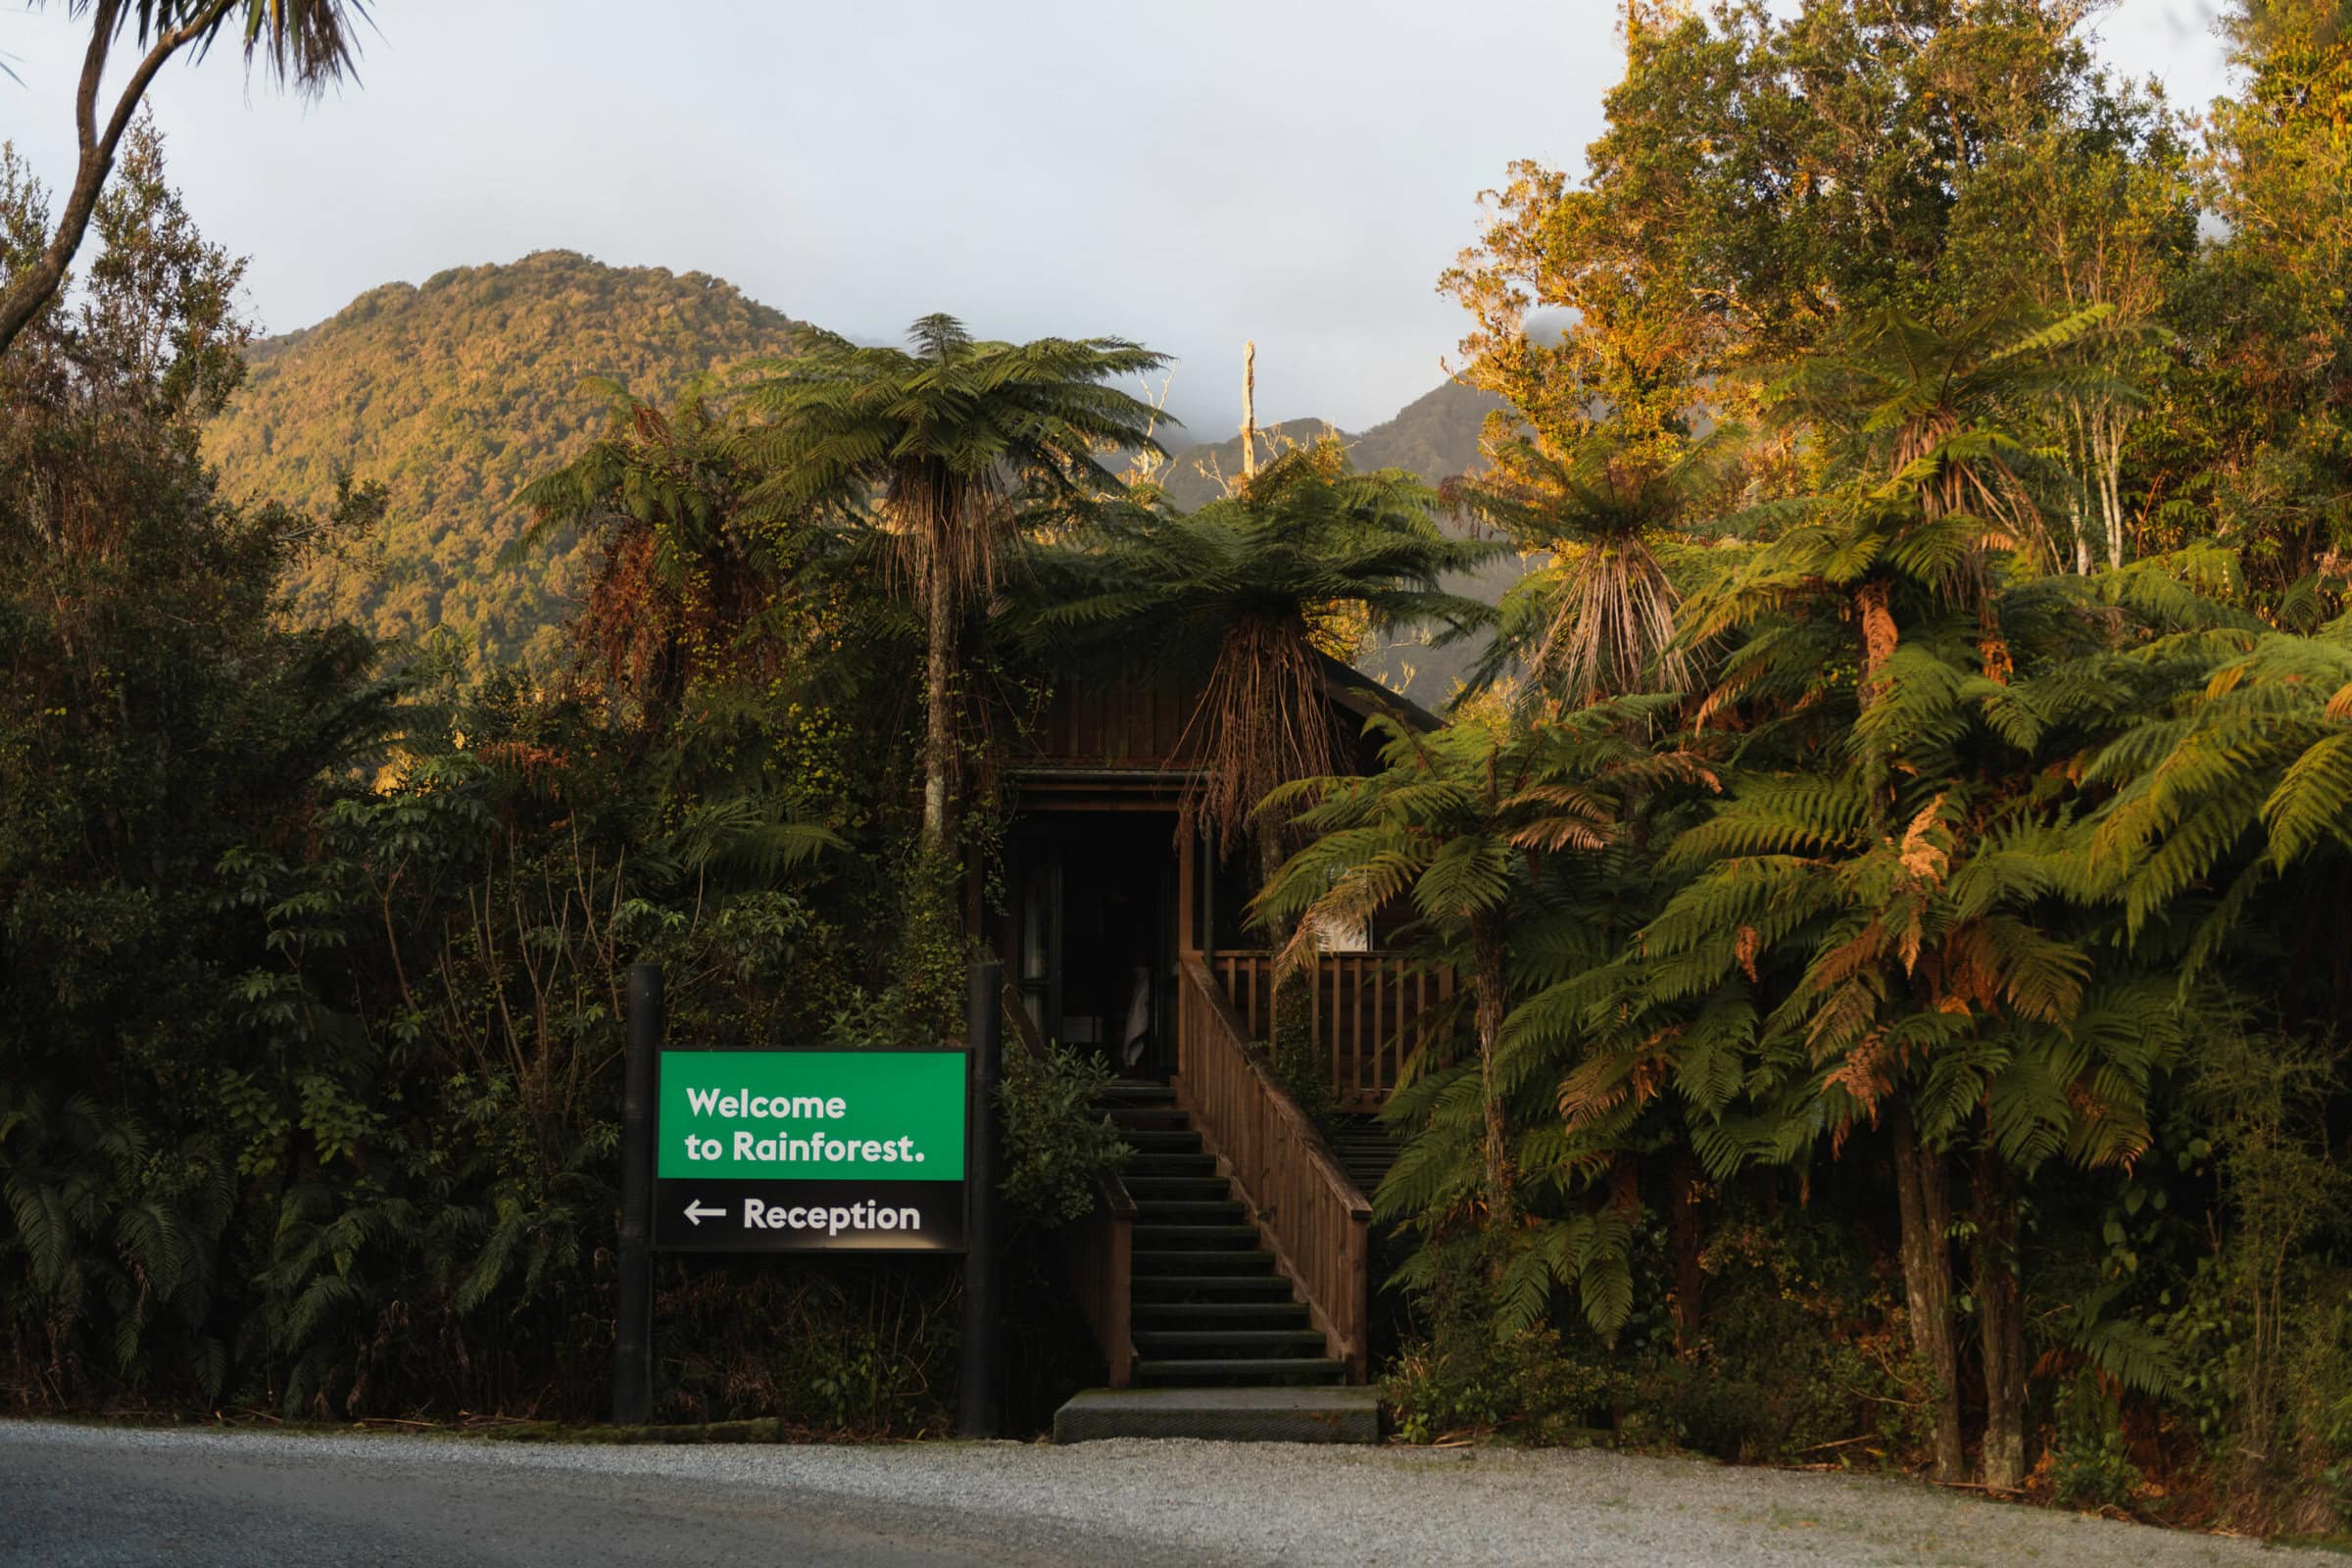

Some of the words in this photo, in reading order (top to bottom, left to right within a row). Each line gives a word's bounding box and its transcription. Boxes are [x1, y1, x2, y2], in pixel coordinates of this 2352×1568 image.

[686, 1088, 847, 1119] Welcome
[685, 1135, 723, 1161] to
[733, 1131, 925, 1162] Rainforest.
[744, 1199, 920, 1237] Reception
